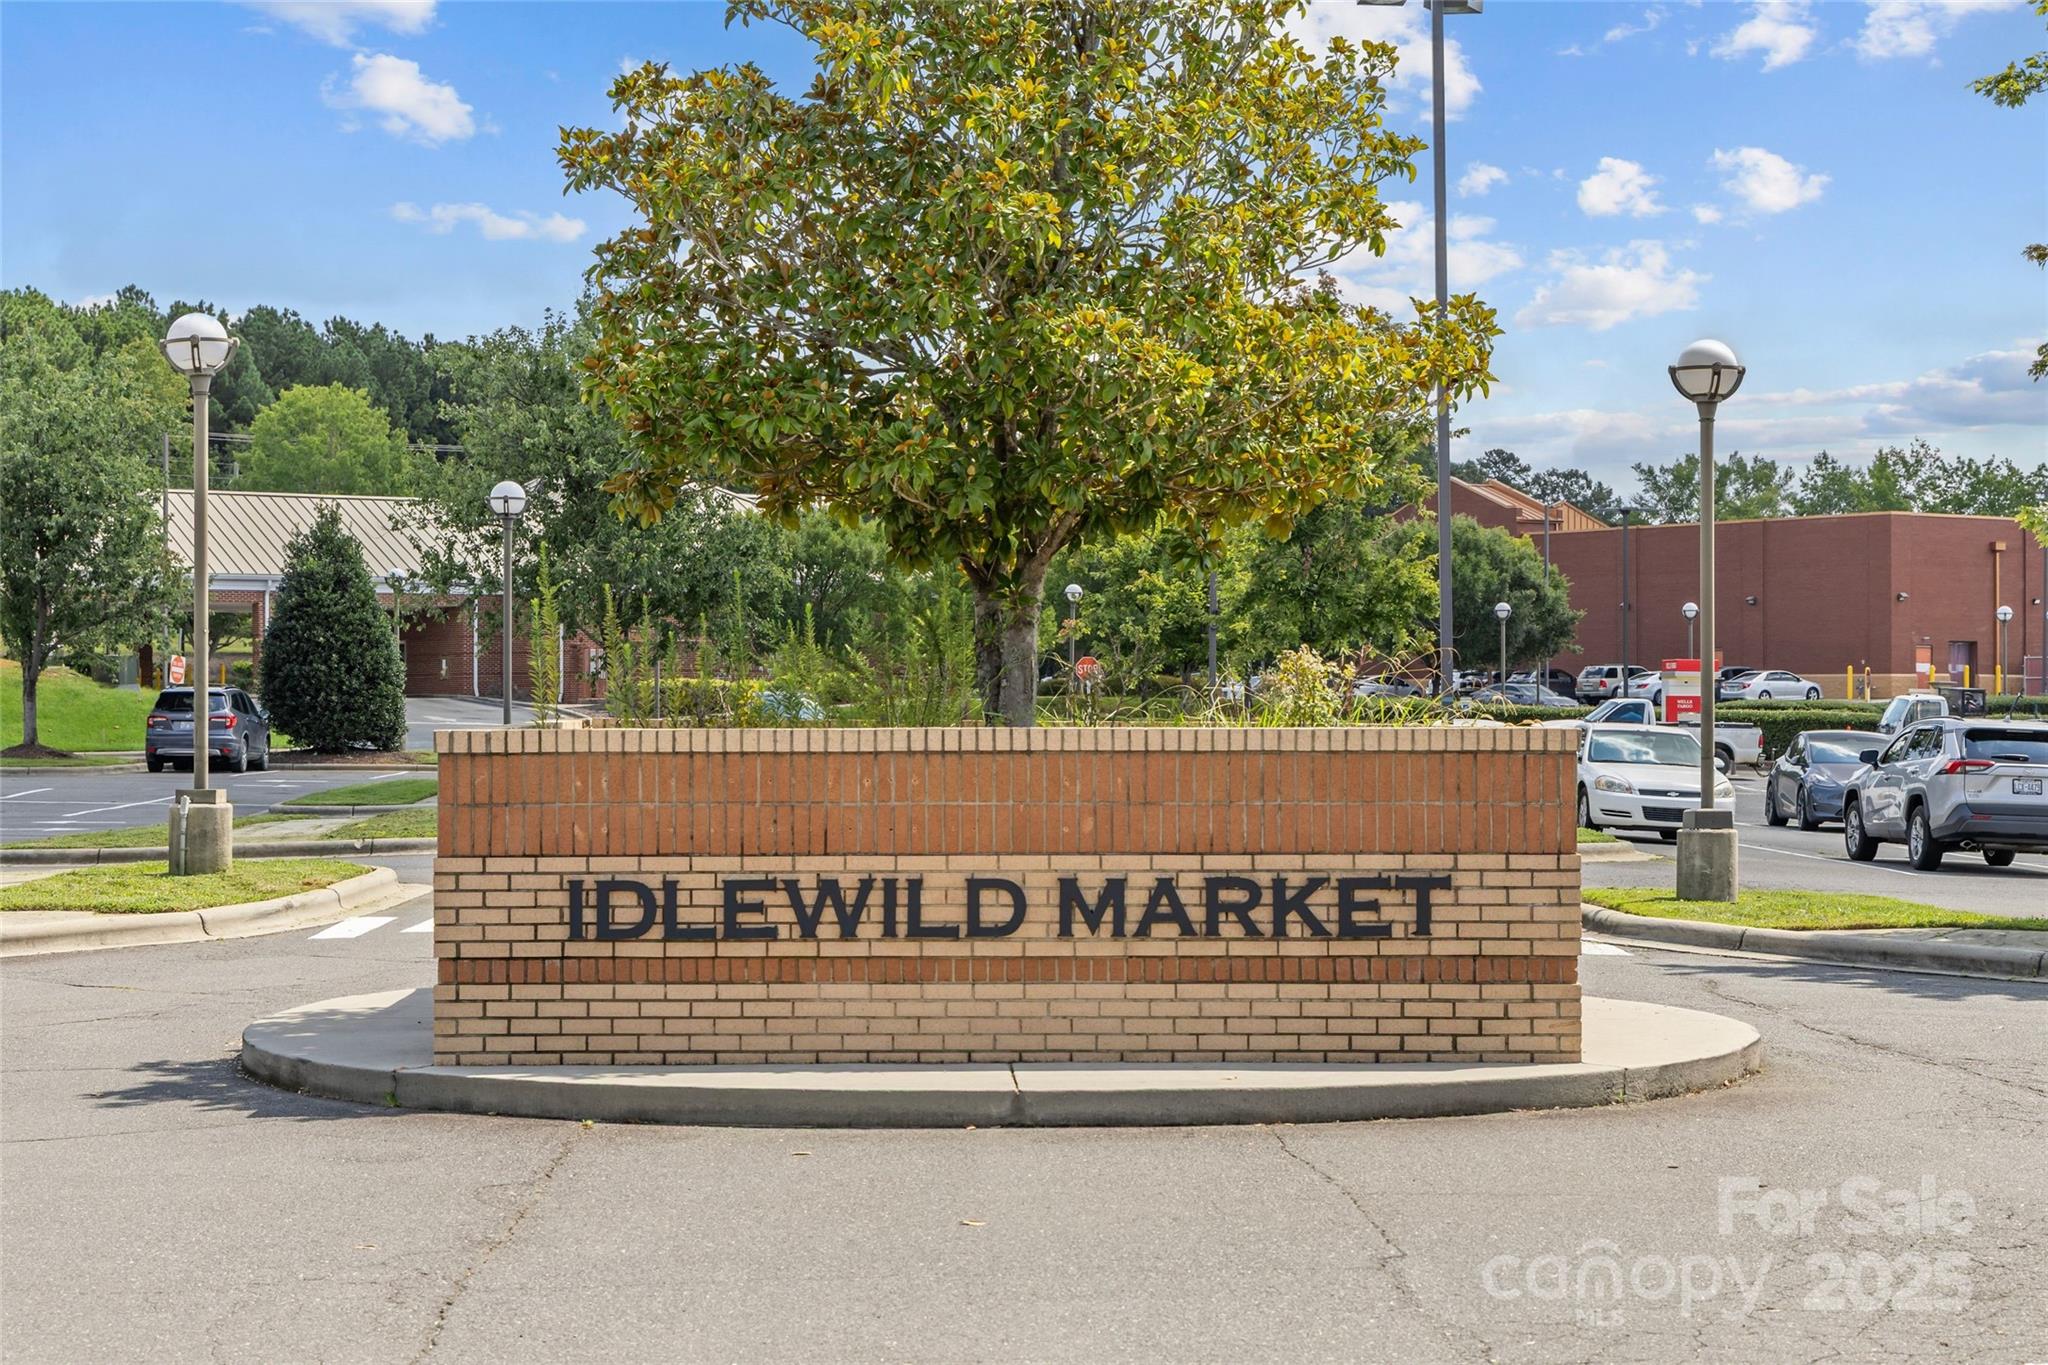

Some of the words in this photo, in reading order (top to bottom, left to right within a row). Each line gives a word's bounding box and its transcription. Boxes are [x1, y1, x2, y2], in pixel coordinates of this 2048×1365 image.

[1078, 665, 1099, 674] STOP
[567, 878, 1027, 940] IDLEWILD
[1057, 875, 1452, 938] MARKET
